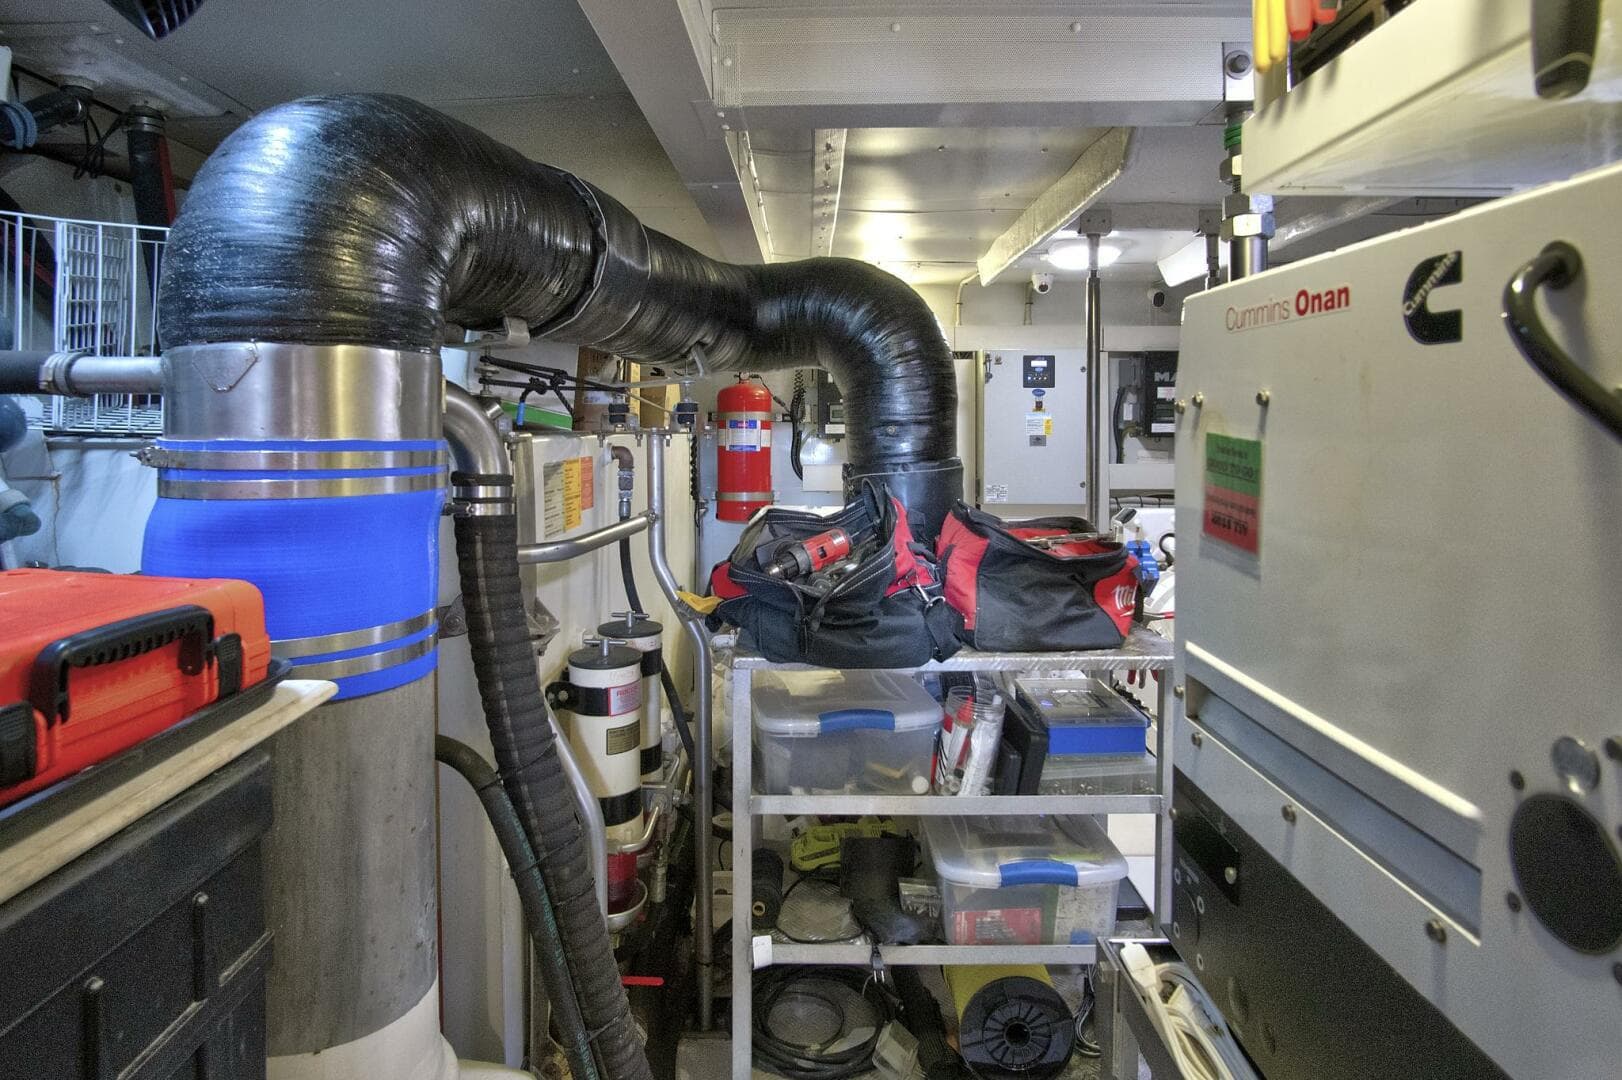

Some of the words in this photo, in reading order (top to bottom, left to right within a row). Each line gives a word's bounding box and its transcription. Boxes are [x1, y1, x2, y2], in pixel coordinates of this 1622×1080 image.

[1225, 299, 1290, 332] Cummins
[1295, 286, 1350, 317] Onan
[1402, 252, 1459, 317] Cummins
